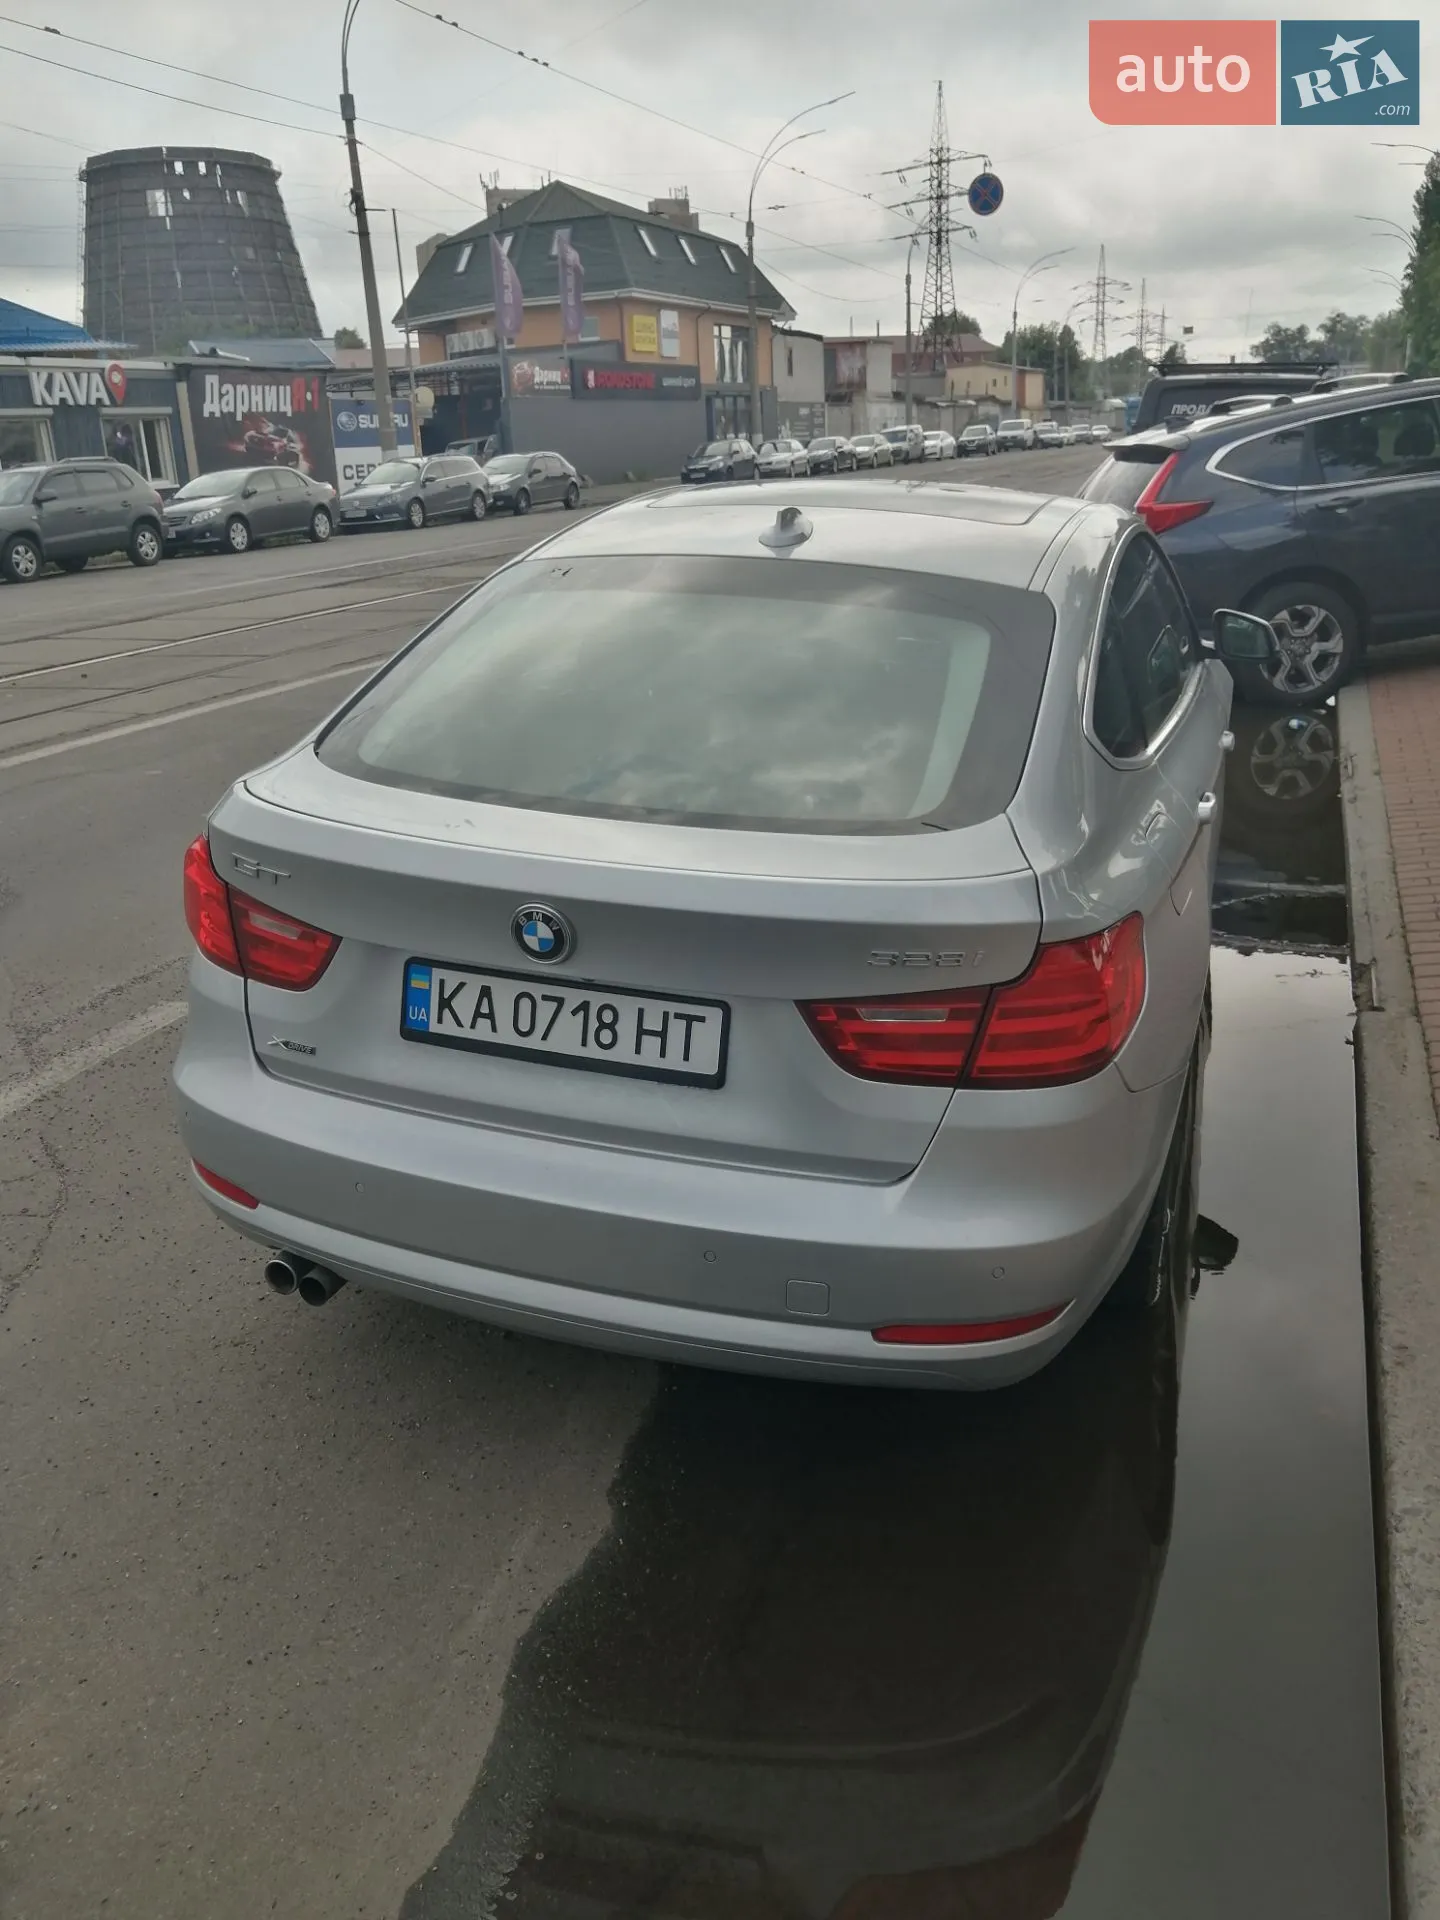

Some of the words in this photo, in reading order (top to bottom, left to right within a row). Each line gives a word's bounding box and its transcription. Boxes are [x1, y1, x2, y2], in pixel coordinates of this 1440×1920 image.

[29, 371, 111, 406] KAVA
[409, 1005, 428, 1022] UA
[437, 978, 498, 1033] KA
[512, 991, 620, 1051] 0718
[634, 1007, 706, 1062] HT
